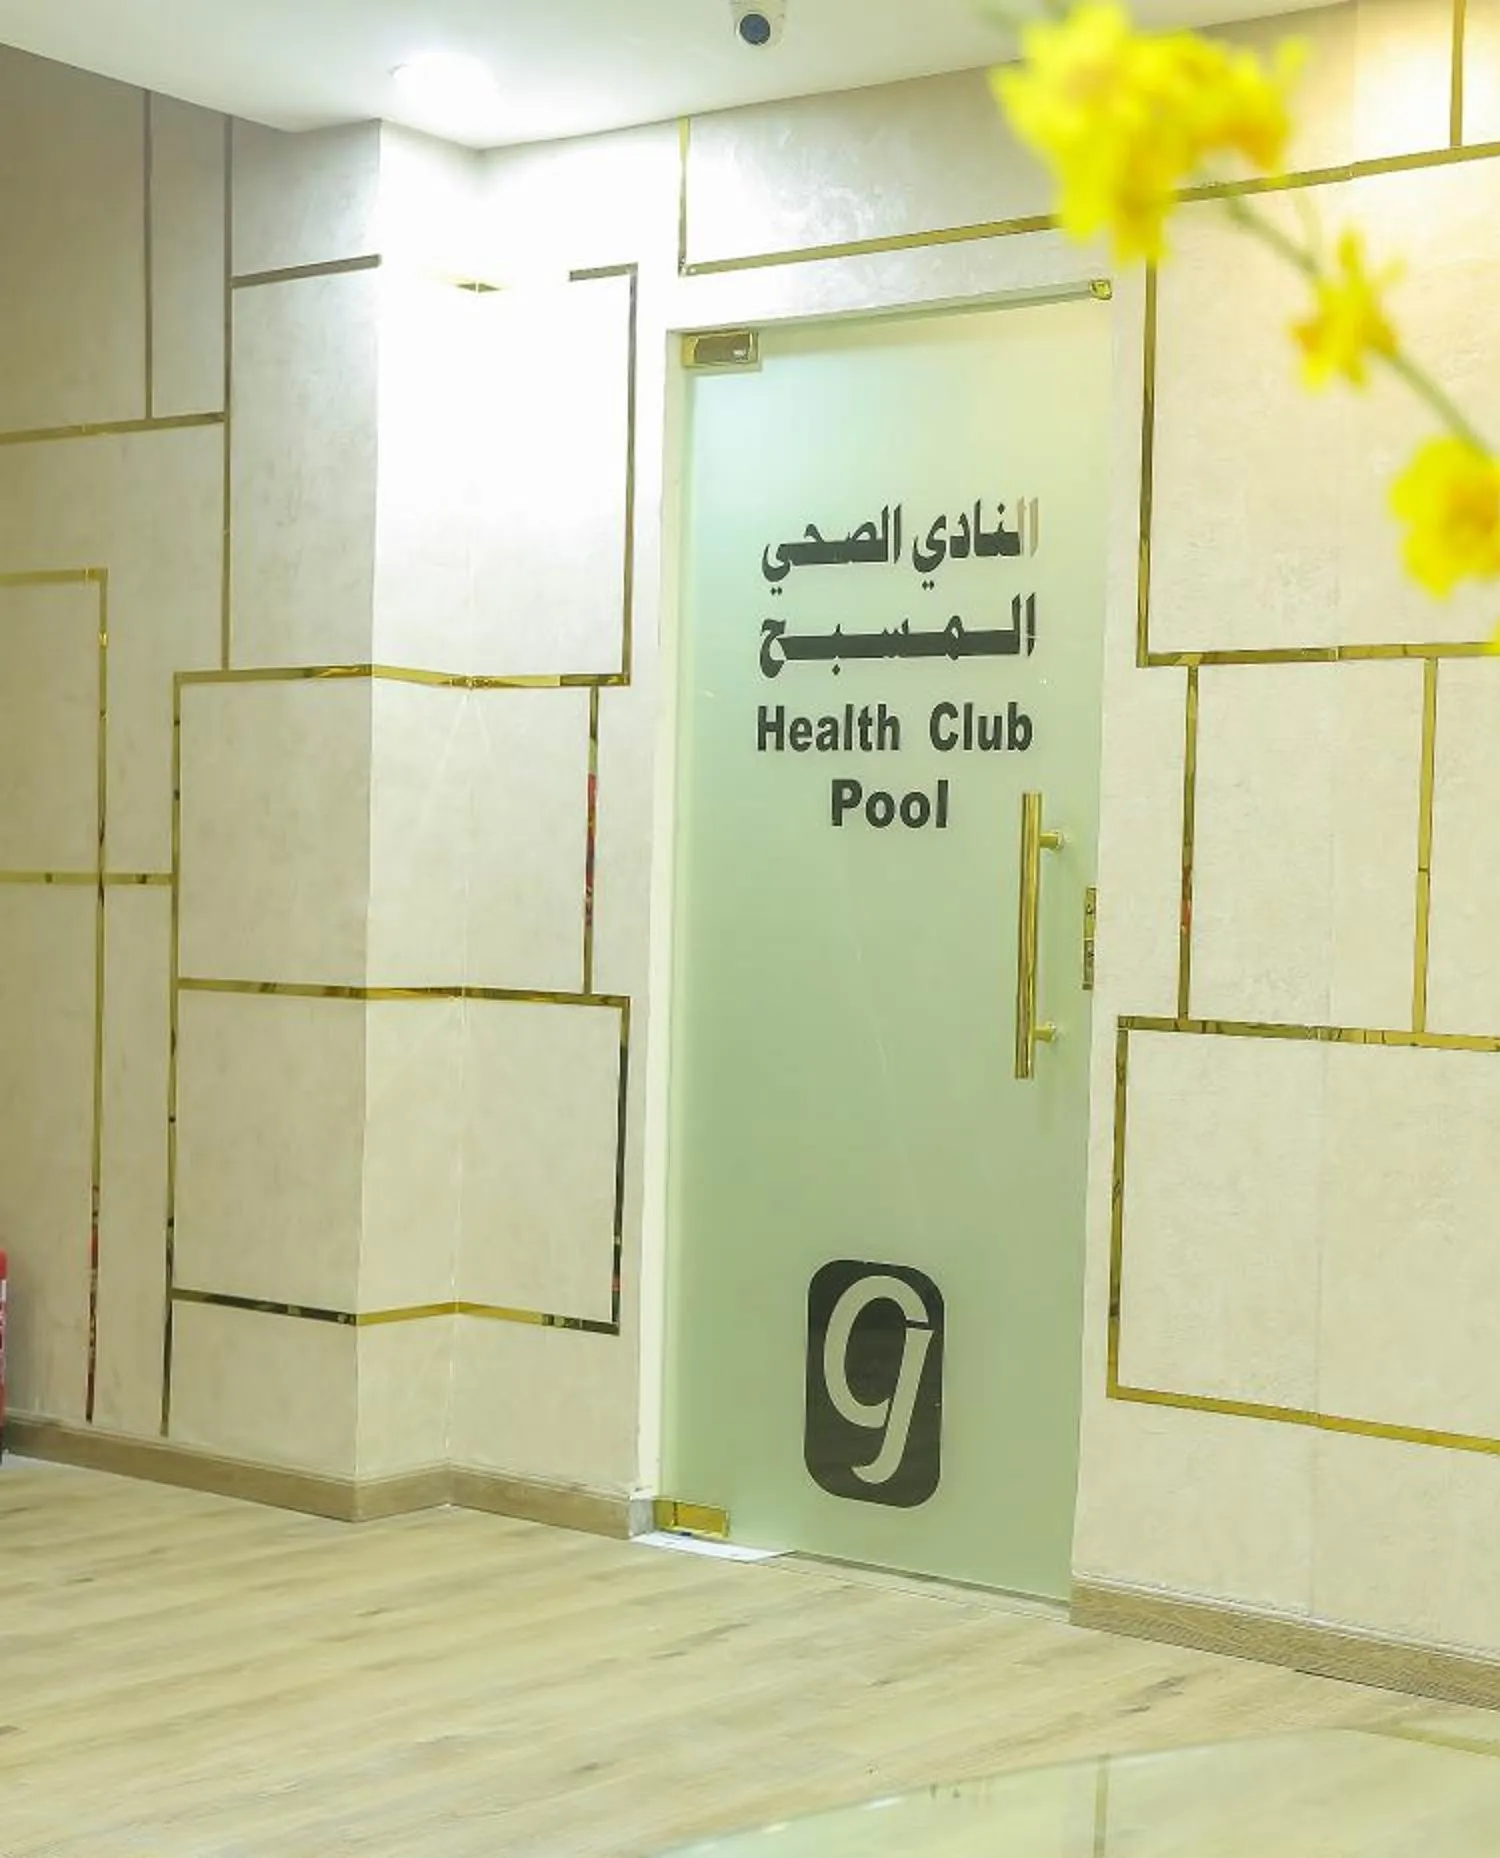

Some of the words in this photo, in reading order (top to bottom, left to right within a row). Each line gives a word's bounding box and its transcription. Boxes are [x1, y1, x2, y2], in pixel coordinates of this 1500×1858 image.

[761, 503, 902, 596] الصحي
[911, 497, 1039, 590] النادي
[759, 592, 1036, 678] المسبح
[757, 703, 901, 751] Health
[929, 701, 1033, 752] Club
[831, 779, 949, 829] Pool
